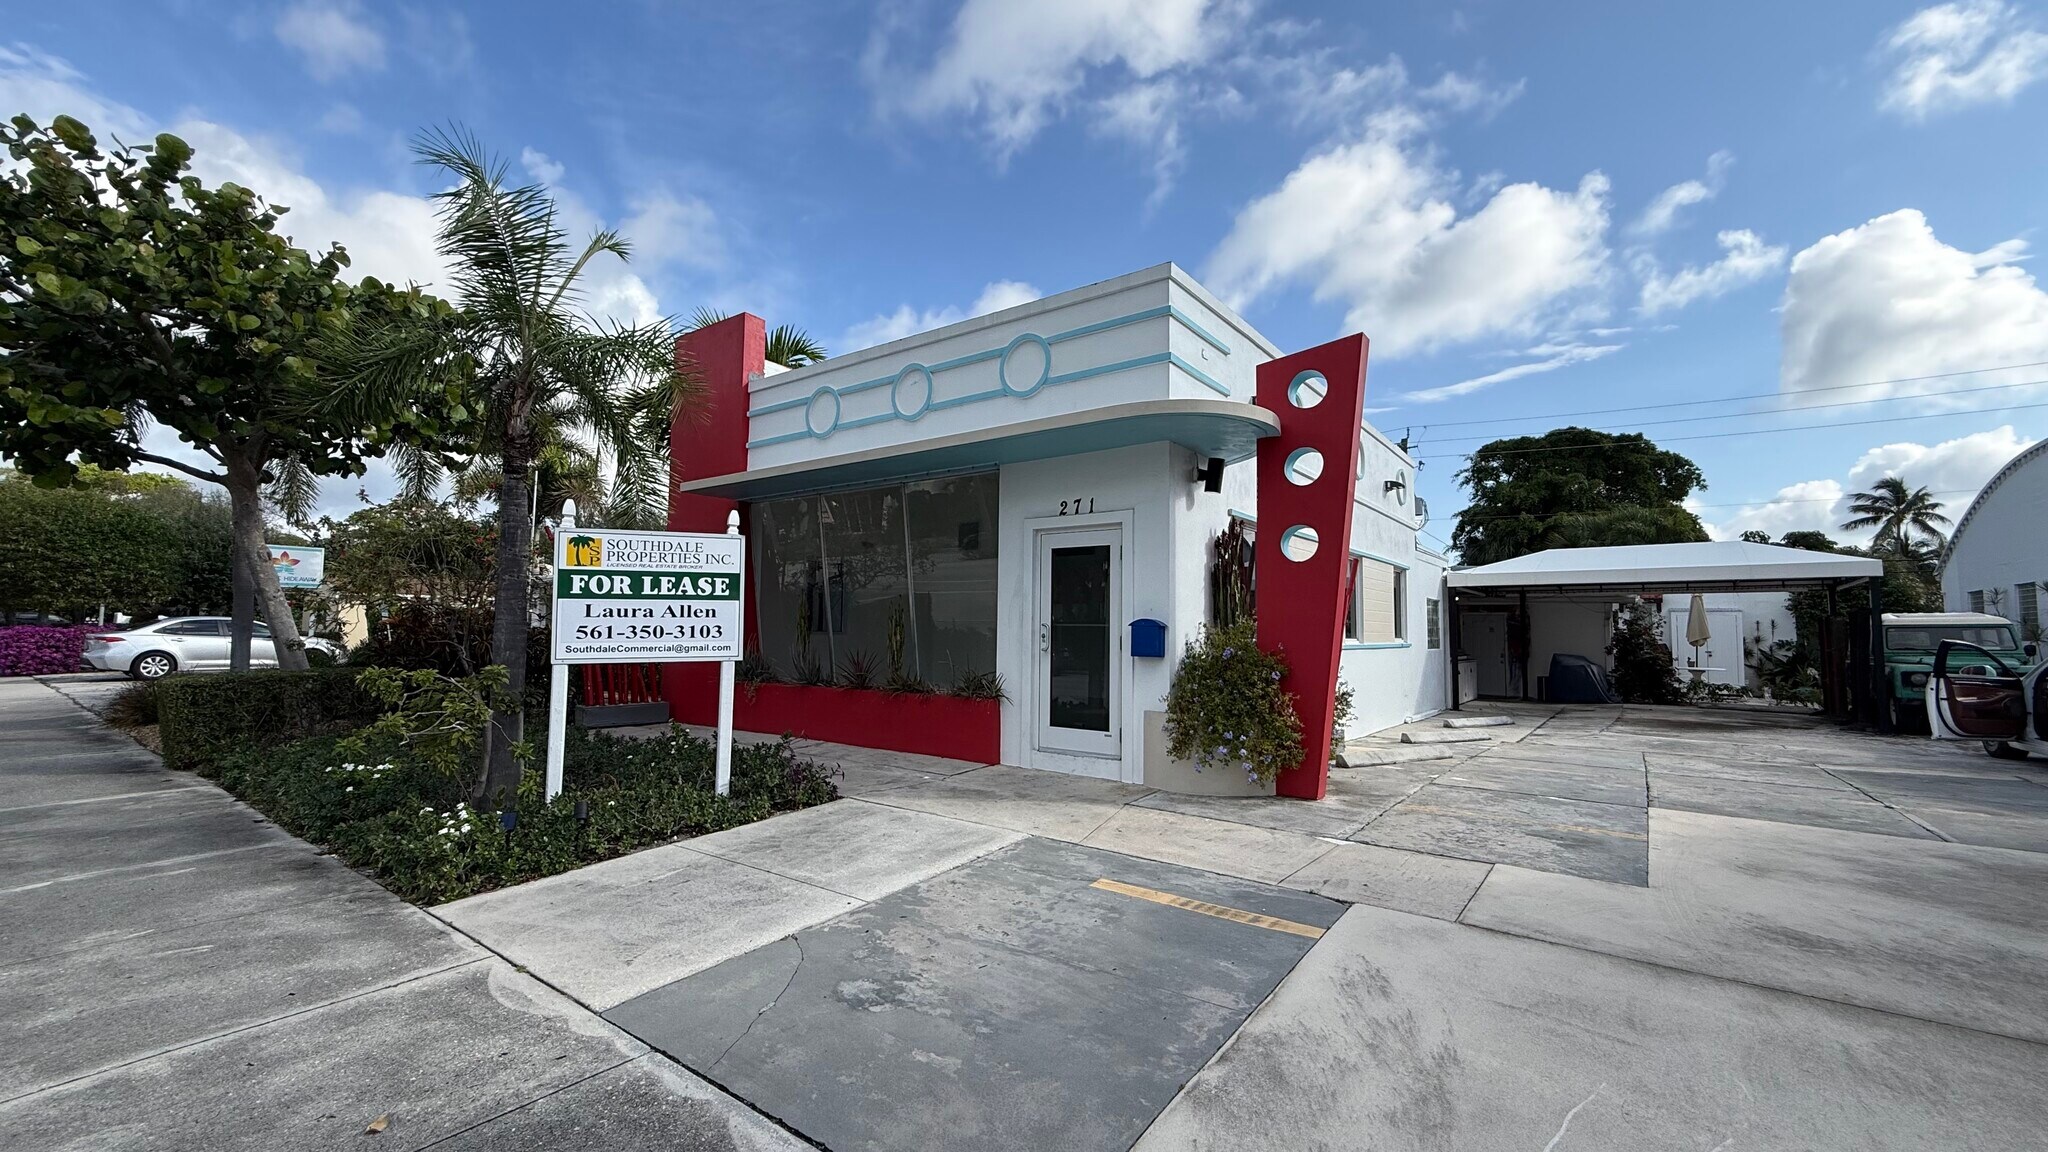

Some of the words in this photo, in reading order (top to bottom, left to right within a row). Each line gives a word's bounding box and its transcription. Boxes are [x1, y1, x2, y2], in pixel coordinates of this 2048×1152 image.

[1058, 497, 1094, 516] 271
[606, 539, 704, 553] SOUTHDALE
[606, 551, 701, 564] PROPERTIES
[705, 553, 735, 565] INC.
[569, 574, 633, 595] FOR
[641, 576, 730, 596] LEASE
[584, 603, 654, 618] Laura
[660, 604, 717, 618] Allen
[575, 624, 723, 640] 561-350-3103
[565, 644, 732, 654] SouthdaleCommercial@gmail.com
